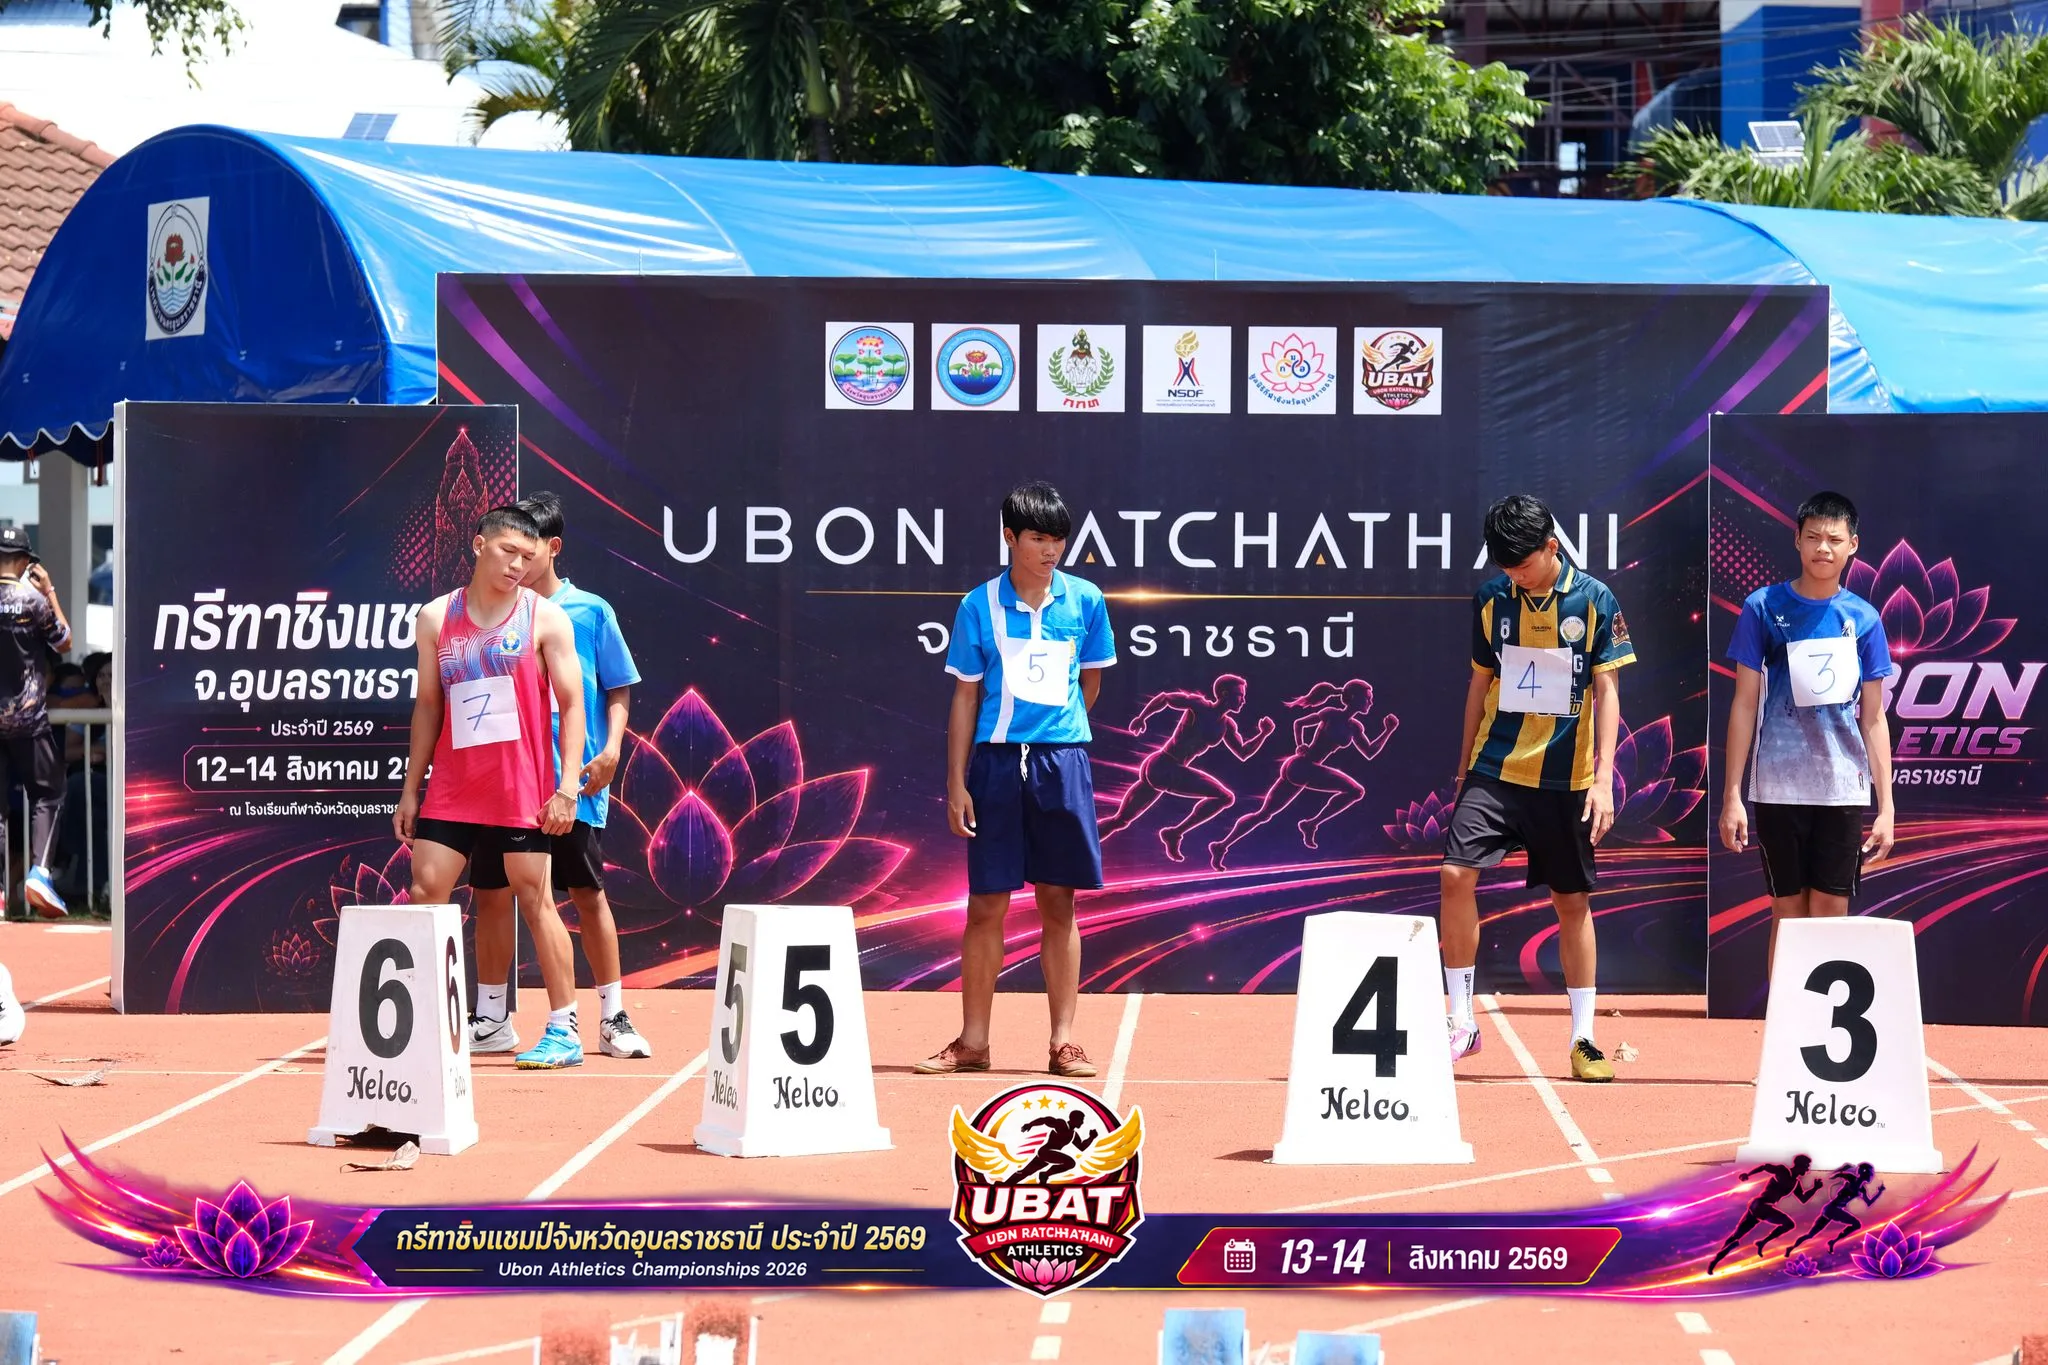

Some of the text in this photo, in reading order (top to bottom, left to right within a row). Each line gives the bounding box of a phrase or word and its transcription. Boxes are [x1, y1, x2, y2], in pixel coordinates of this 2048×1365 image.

[1167, 389, 1204, 397] NSDF
[1367, 372, 1428, 387] UBAT
[664, 506, 1617, 570] UBON ATCHATHNI
[154, 589, 421, 650] กรีฑาชิงแช
[1026, 652, 1048, 684] 5
[1517, 660, 1542, 699] 4
[1808, 653, 1836, 695] 3
[195, 668, 418, 713] จ.อุบลราชธา
[271, 717, 374, 736] ประจำปี 2569
[462, 693, 491, 731] 7
[1894, 726, 2034, 755] ETICS
[196, 756, 277, 782] 12-14
[286, 755, 379, 781] สิงหาคม
[1892, 764, 1983, 785] ลราชธานี
[229, 801, 399, 818] ณ โรงเรียนกีฬาจังหวัดอุบลราช
[359, 938, 414, 1058] 6
[445, 936, 461, 1054] 6
[721, 943, 747, 1064] 5
[780, 945, 834, 1065] 5
[1332, 956, 1407, 1077] 4
[1800, 960, 1877, 1082] 3
[347, 1066, 412, 1103] Nelco
[711, 1069, 738, 1110] Nelco
[773, 1076, 839, 1109] Nelco
[1320, 1086, 1410, 1121] Nelco
[1785, 1090, 1877, 1127] Nelco
